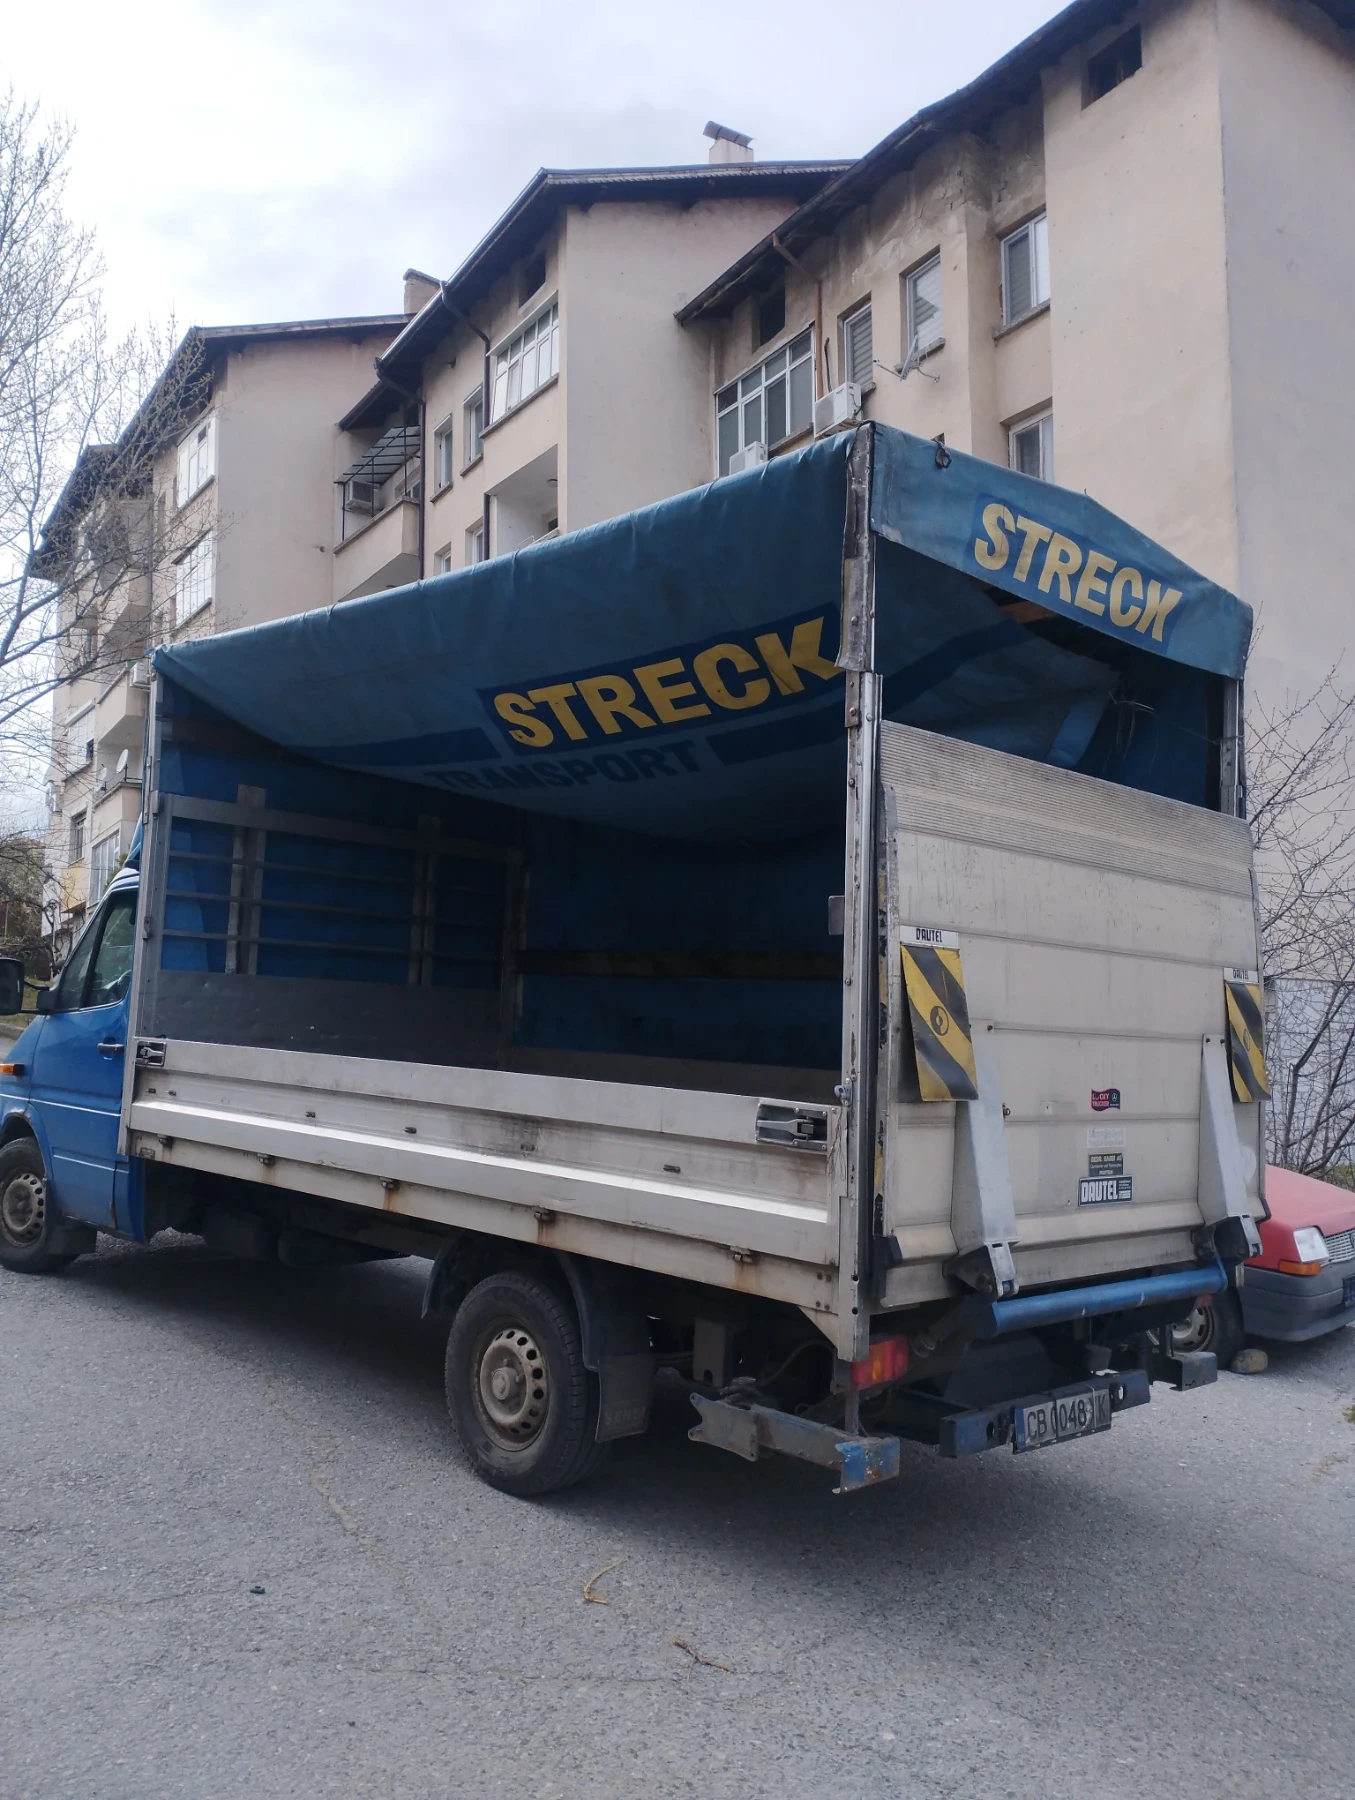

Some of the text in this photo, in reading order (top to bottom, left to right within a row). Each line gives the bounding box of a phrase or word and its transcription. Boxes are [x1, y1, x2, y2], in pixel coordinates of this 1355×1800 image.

[974, 503, 1183, 642] STRECK
[494, 616, 845, 748] STRECK
[423, 739, 701, 791] TRANSPORT
[915, 927, 943, 943] DAUTEL
[1081, 1180, 1118, 1203] DAUTEL
